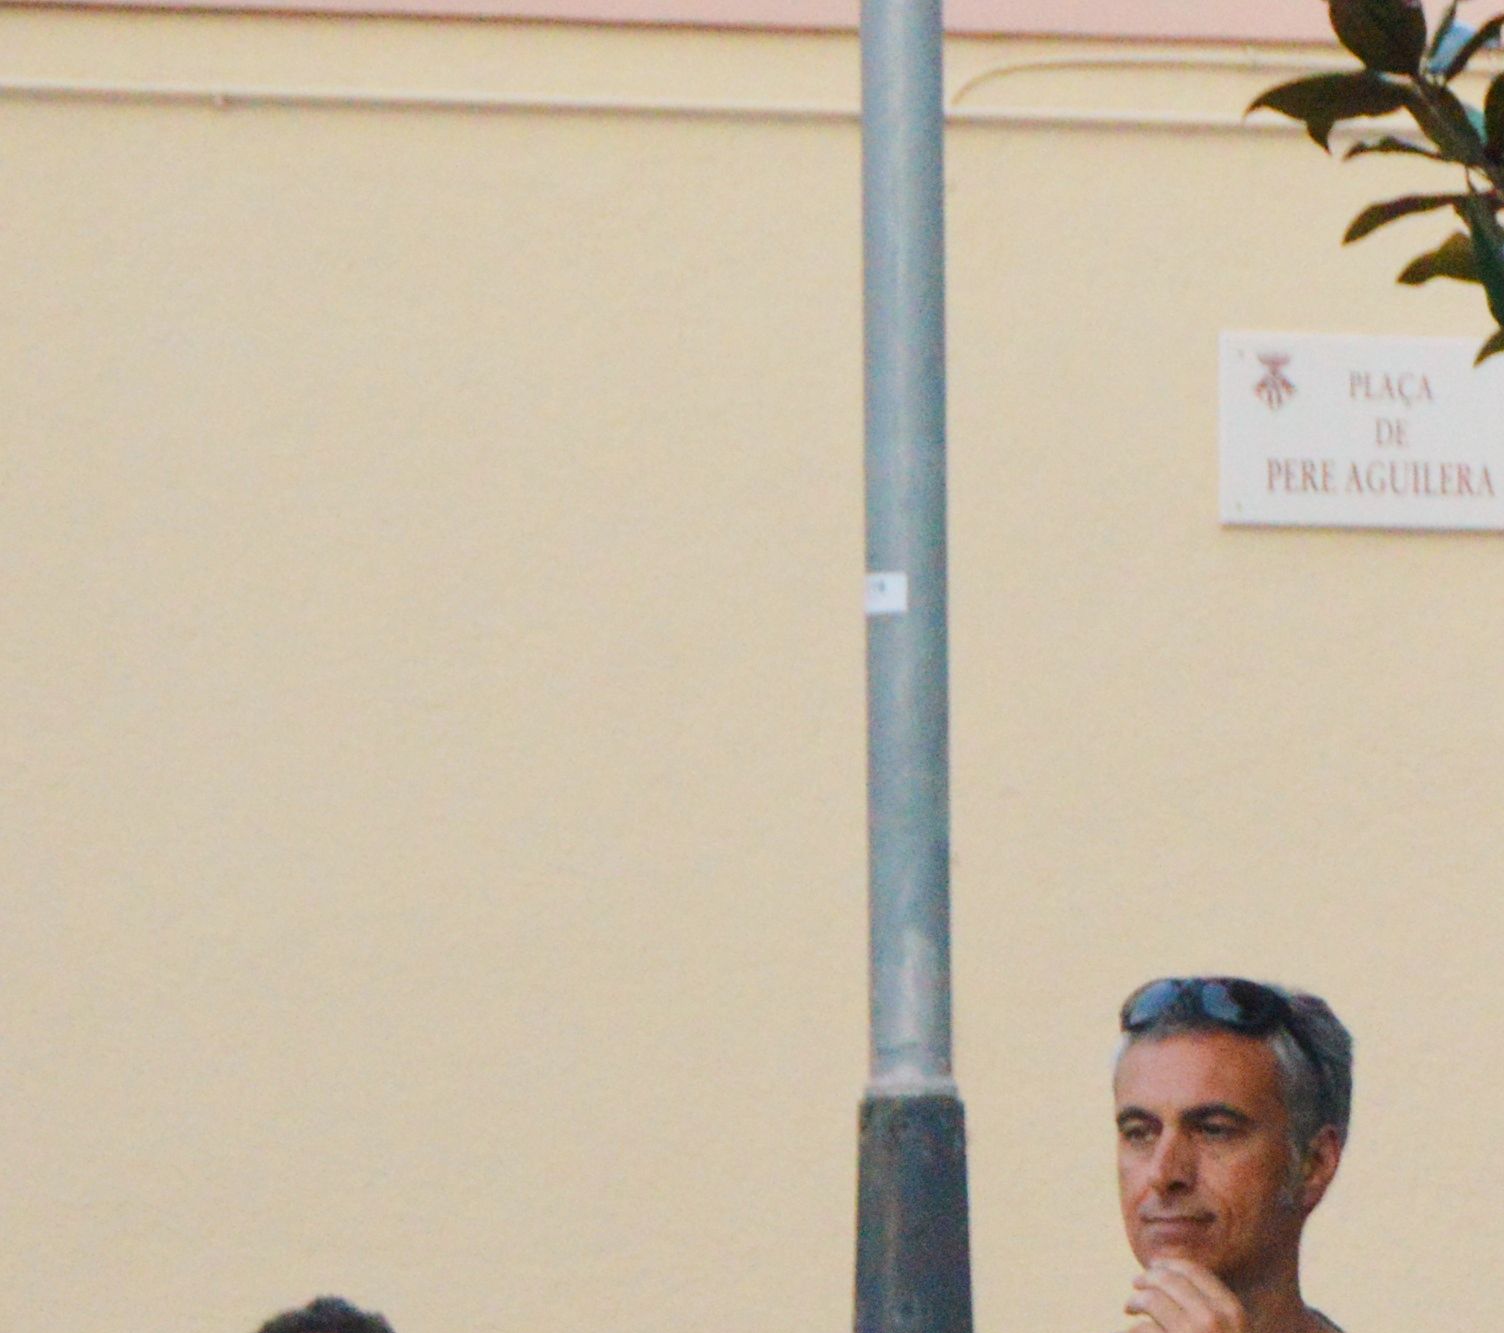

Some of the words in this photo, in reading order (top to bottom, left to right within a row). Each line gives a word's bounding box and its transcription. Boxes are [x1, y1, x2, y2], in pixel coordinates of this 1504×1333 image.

[1348, 371, 1434, 407] PLAÇA
[1374, 417, 1409, 447] DE
[1266, 458, 1335, 495] PERE
[1345, 459, 1496, 498] AGUILERA
